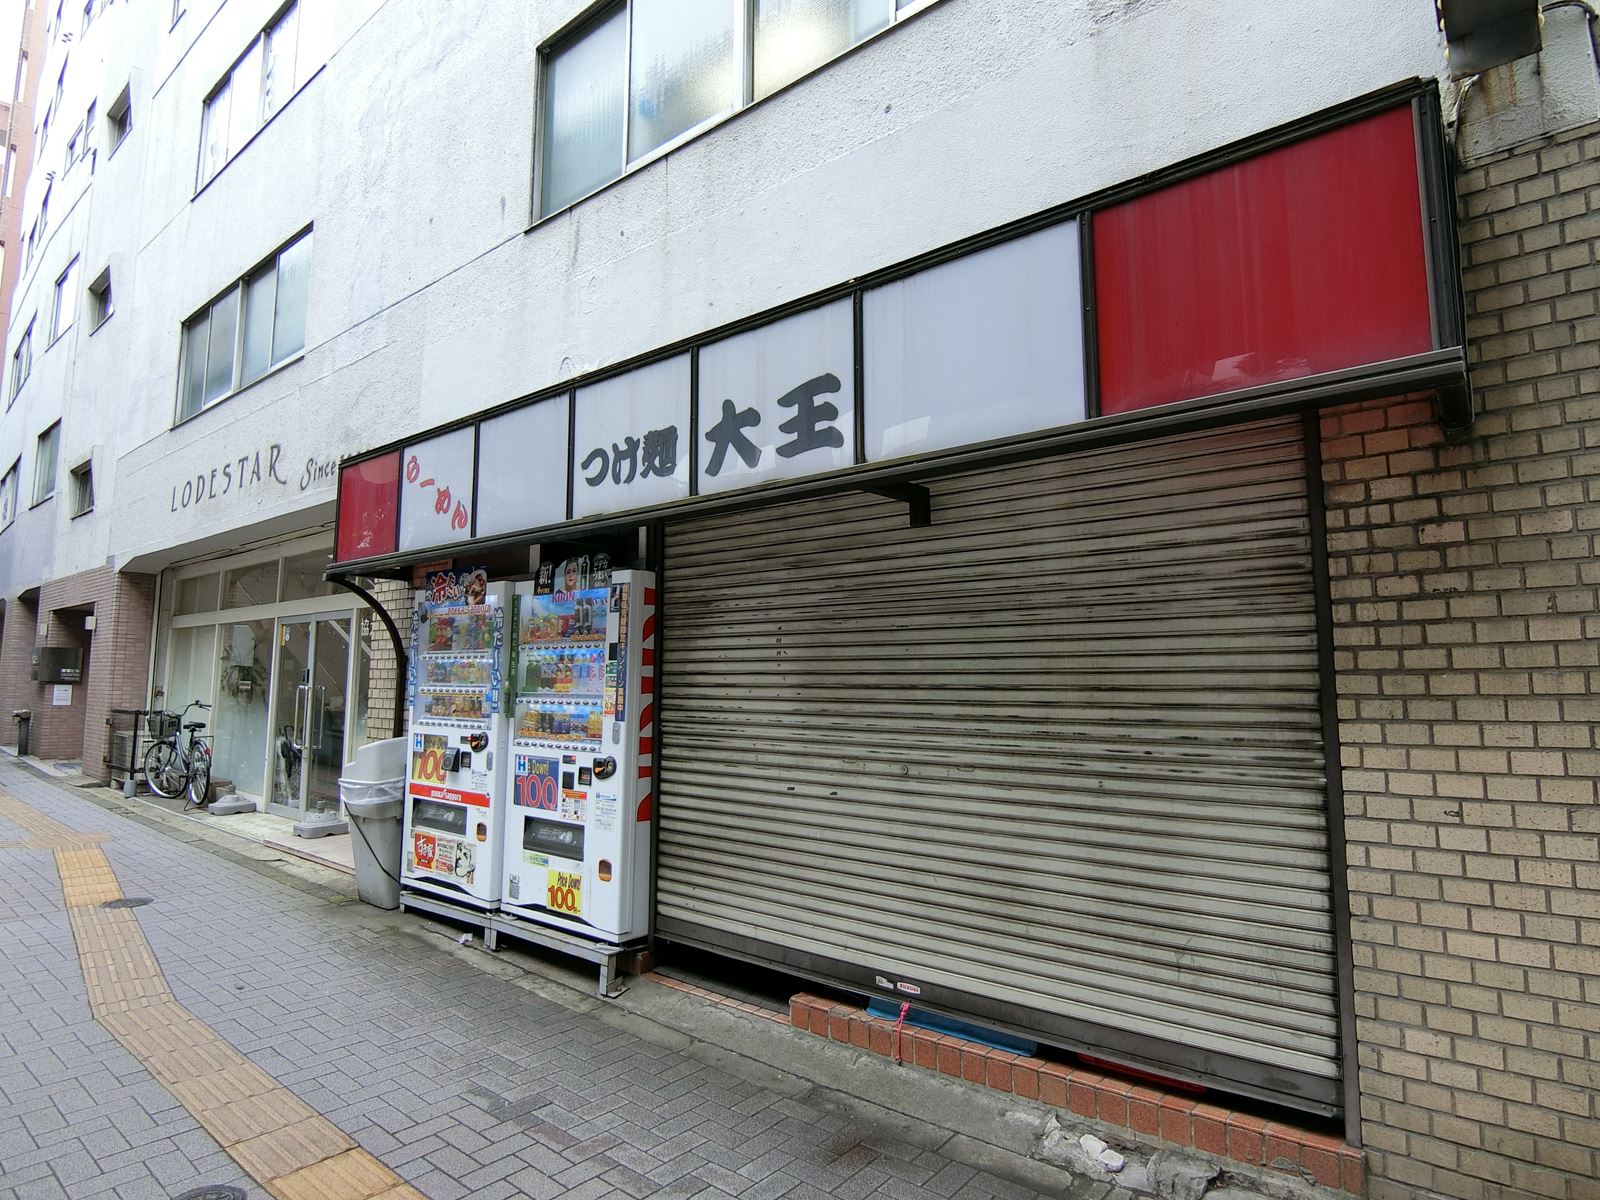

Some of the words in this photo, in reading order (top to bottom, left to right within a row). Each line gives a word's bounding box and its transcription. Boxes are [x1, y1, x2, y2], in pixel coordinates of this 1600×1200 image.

[581, 425, 679, 487] つけ麺
[705, 373, 844, 476] 大王
[171, 444, 287, 512] LODESTAR
[299, 457, 336, 491] Since
[406, 455, 469, 530] らーめん
[552, 591, 575, 603] KIRIN
[531, 760, 549, 776] Down!
[517, 774, 558, 811] 100
[557, 872, 568, 888] Price
[568, 873, 581, 891] Down!
